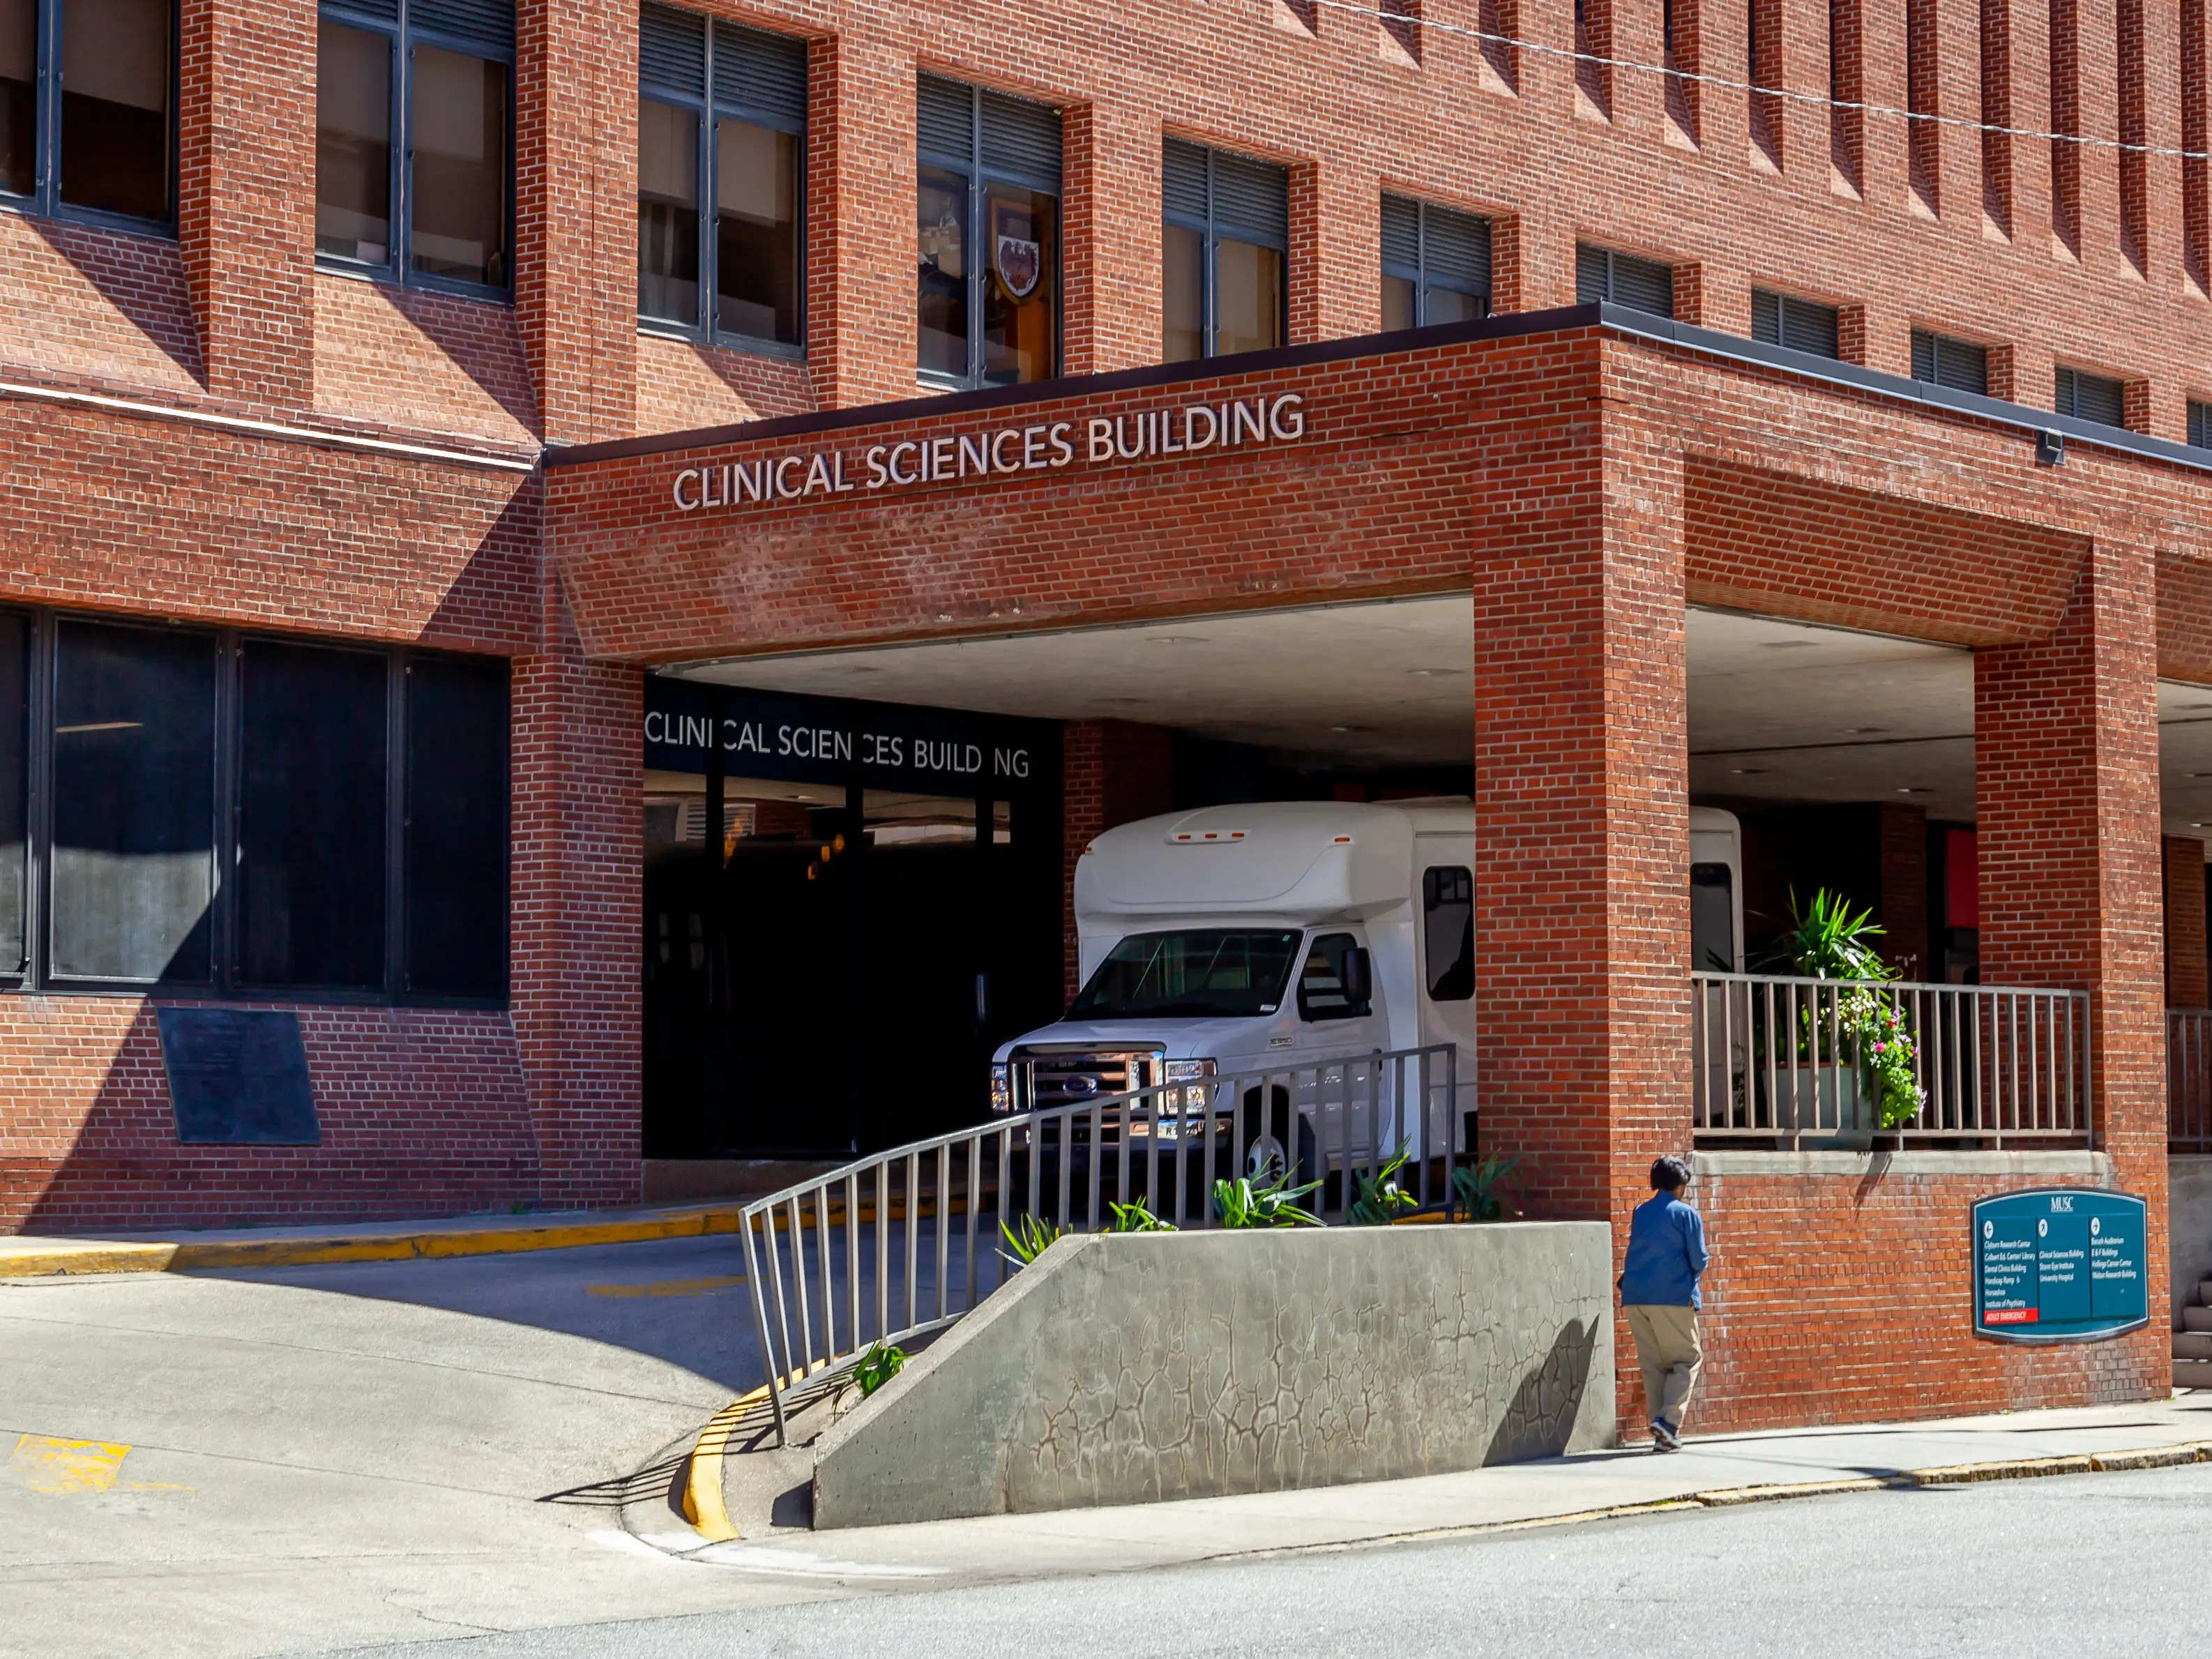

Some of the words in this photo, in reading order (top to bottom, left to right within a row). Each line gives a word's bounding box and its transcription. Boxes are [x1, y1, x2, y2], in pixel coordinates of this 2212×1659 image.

[673, 451, 854, 512] CLINICAL
[866, 422, 1075, 488] SCIENCES
[1087, 393, 1305, 463] BUILDING
[644, 711, 771, 754] CLINICAL
[778, 725, 903, 766] SCIENCES
[914, 739, 1029, 778] BUILDNG
[2051, 1196, 2074, 1211] MUSC
[2017, 1240, 2031, 1248] Center
[2039, 1250, 2052, 1259] Clinical
[2053, 1250, 2068, 1259] Sciences
[2069, 1250, 2084, 1259] Building
[2120, 1259, 2132, 1267] Center
[2011, 1264, 2027, 1274] Building
[2059, 1273, 2074, 1282] Hospital
[2121, 1270, 2136, 1280] Building
[2003, 1276, 2015, 1286] Ramp
[2002, 1299, 2006, 1308] of
[2000, 1311, 2027, 1321] EMERGENCY
